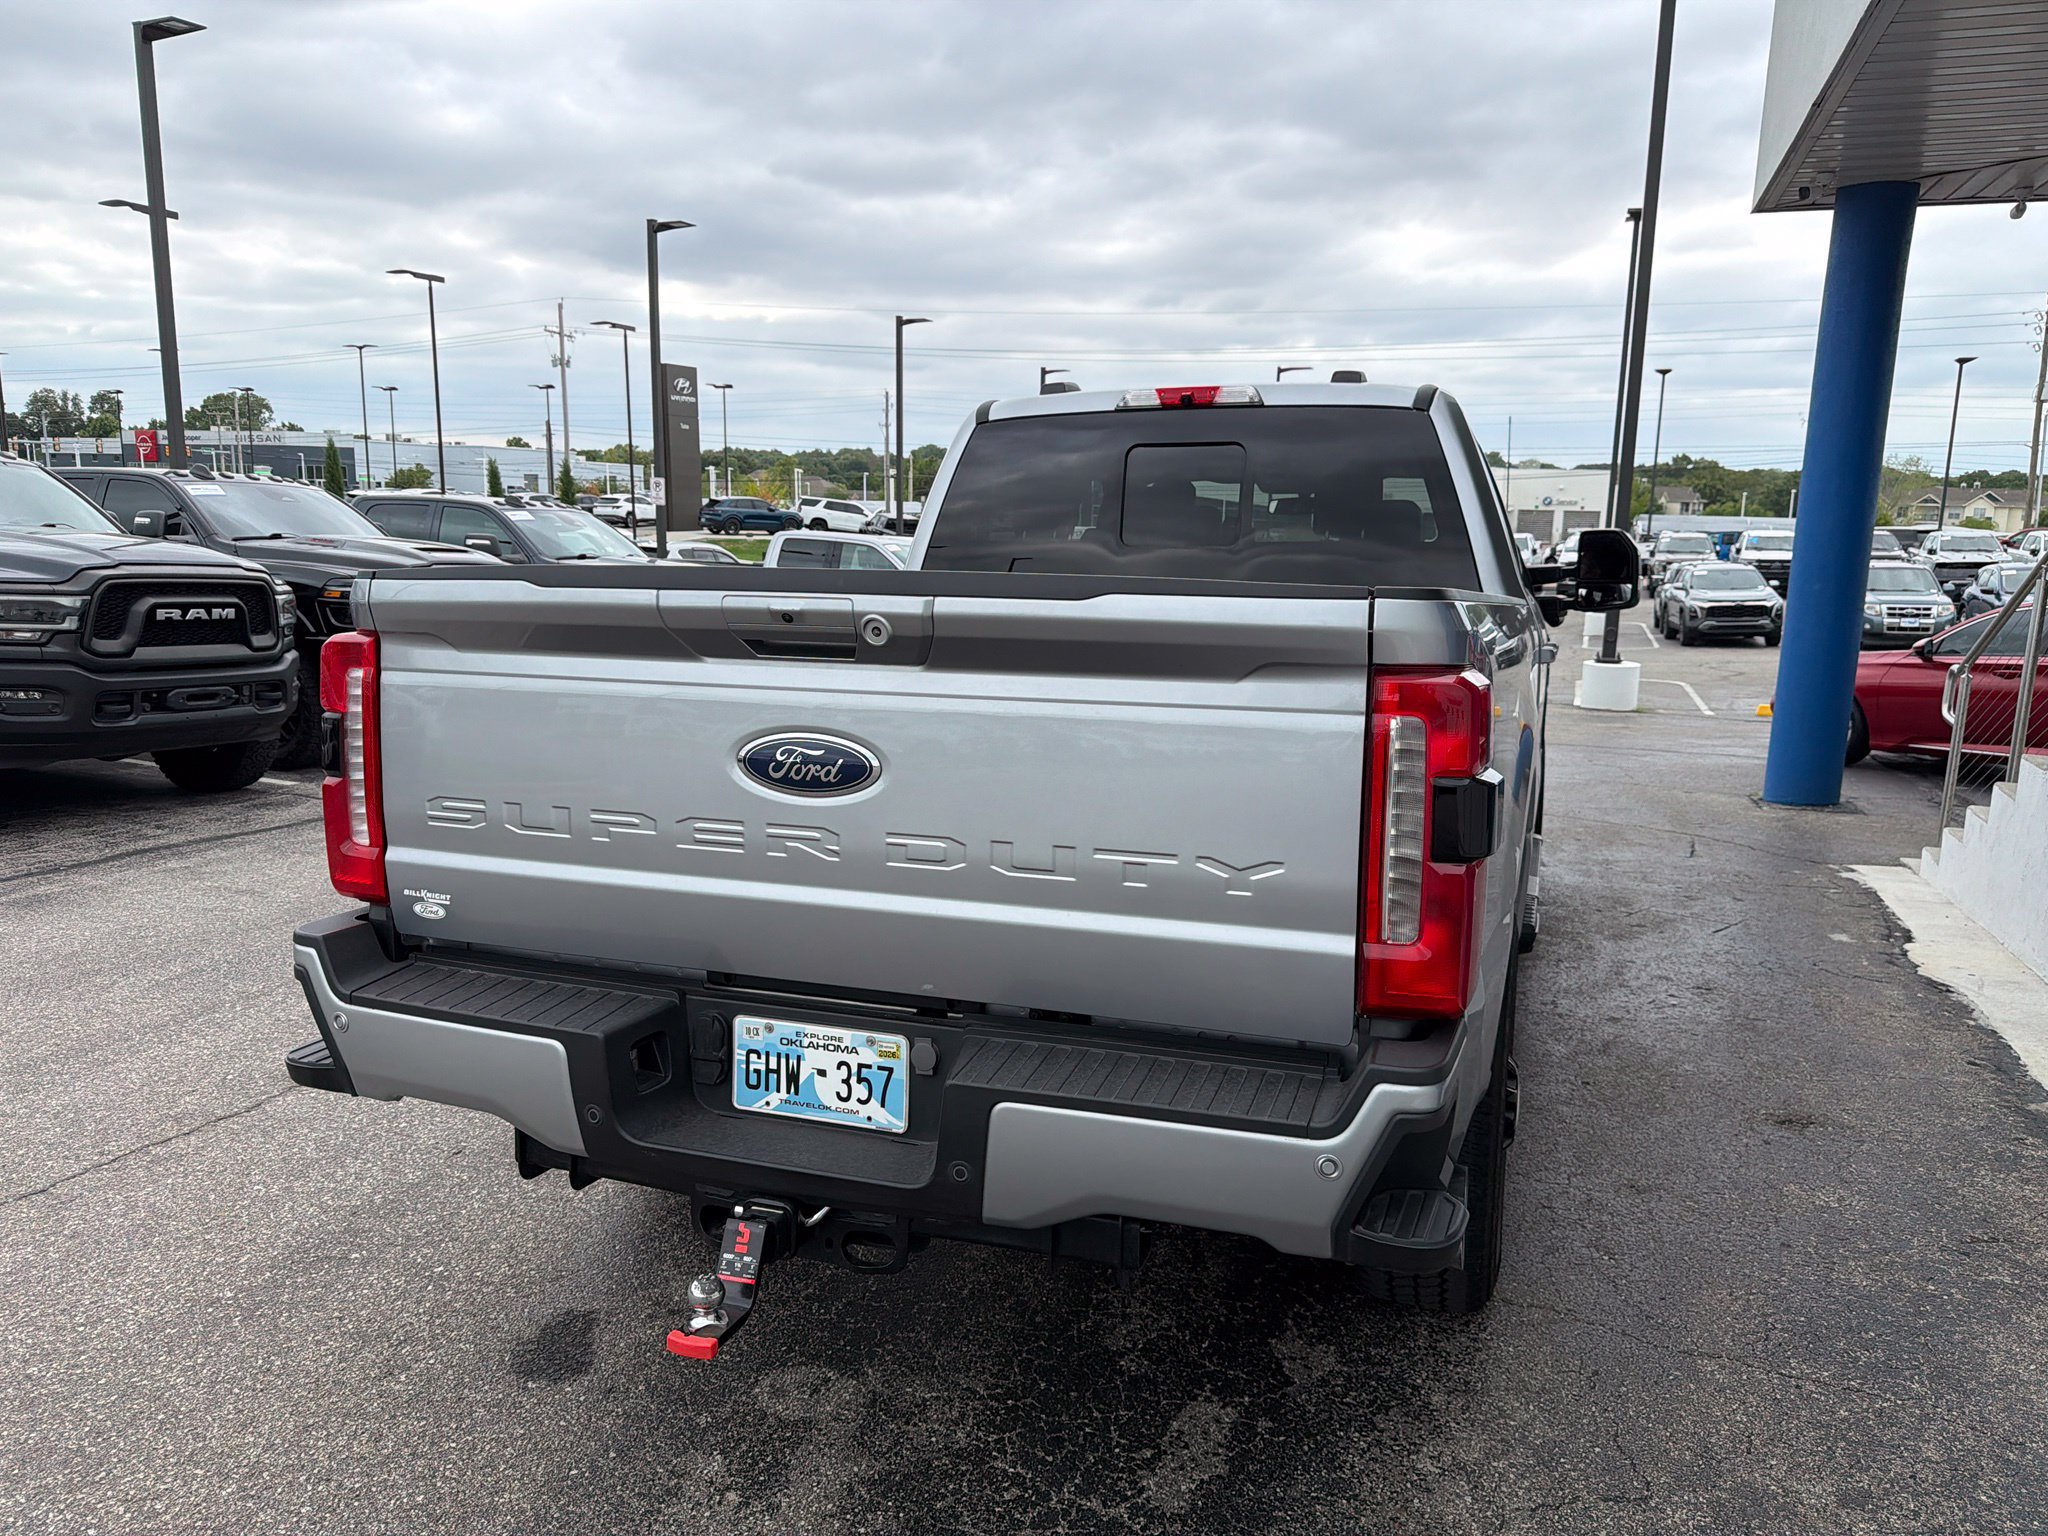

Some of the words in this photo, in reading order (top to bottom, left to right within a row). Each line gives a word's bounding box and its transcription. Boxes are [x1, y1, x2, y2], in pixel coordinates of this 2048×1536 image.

[235, 434, 281, 443] NISSAN
[156, 608, 236, 620] RAM
[768, 745, 844, 783] Ford
[426, 795, 841, 862] SUPER
[885, 831, 1286, 896] DUTY
[420, 904, 440, 916] Ford
[795, 1031, 844, 1043] EXPLORE
[779, 1037, 860, 1056] OKLAHOMA
[878, 1049, 897, 1059] 2026
[744, 1048, 801, 1097] GHW
[835, 1060, 895, 1109] 357
[779, 1098, 860, 1116] TRAVELOK.COM
